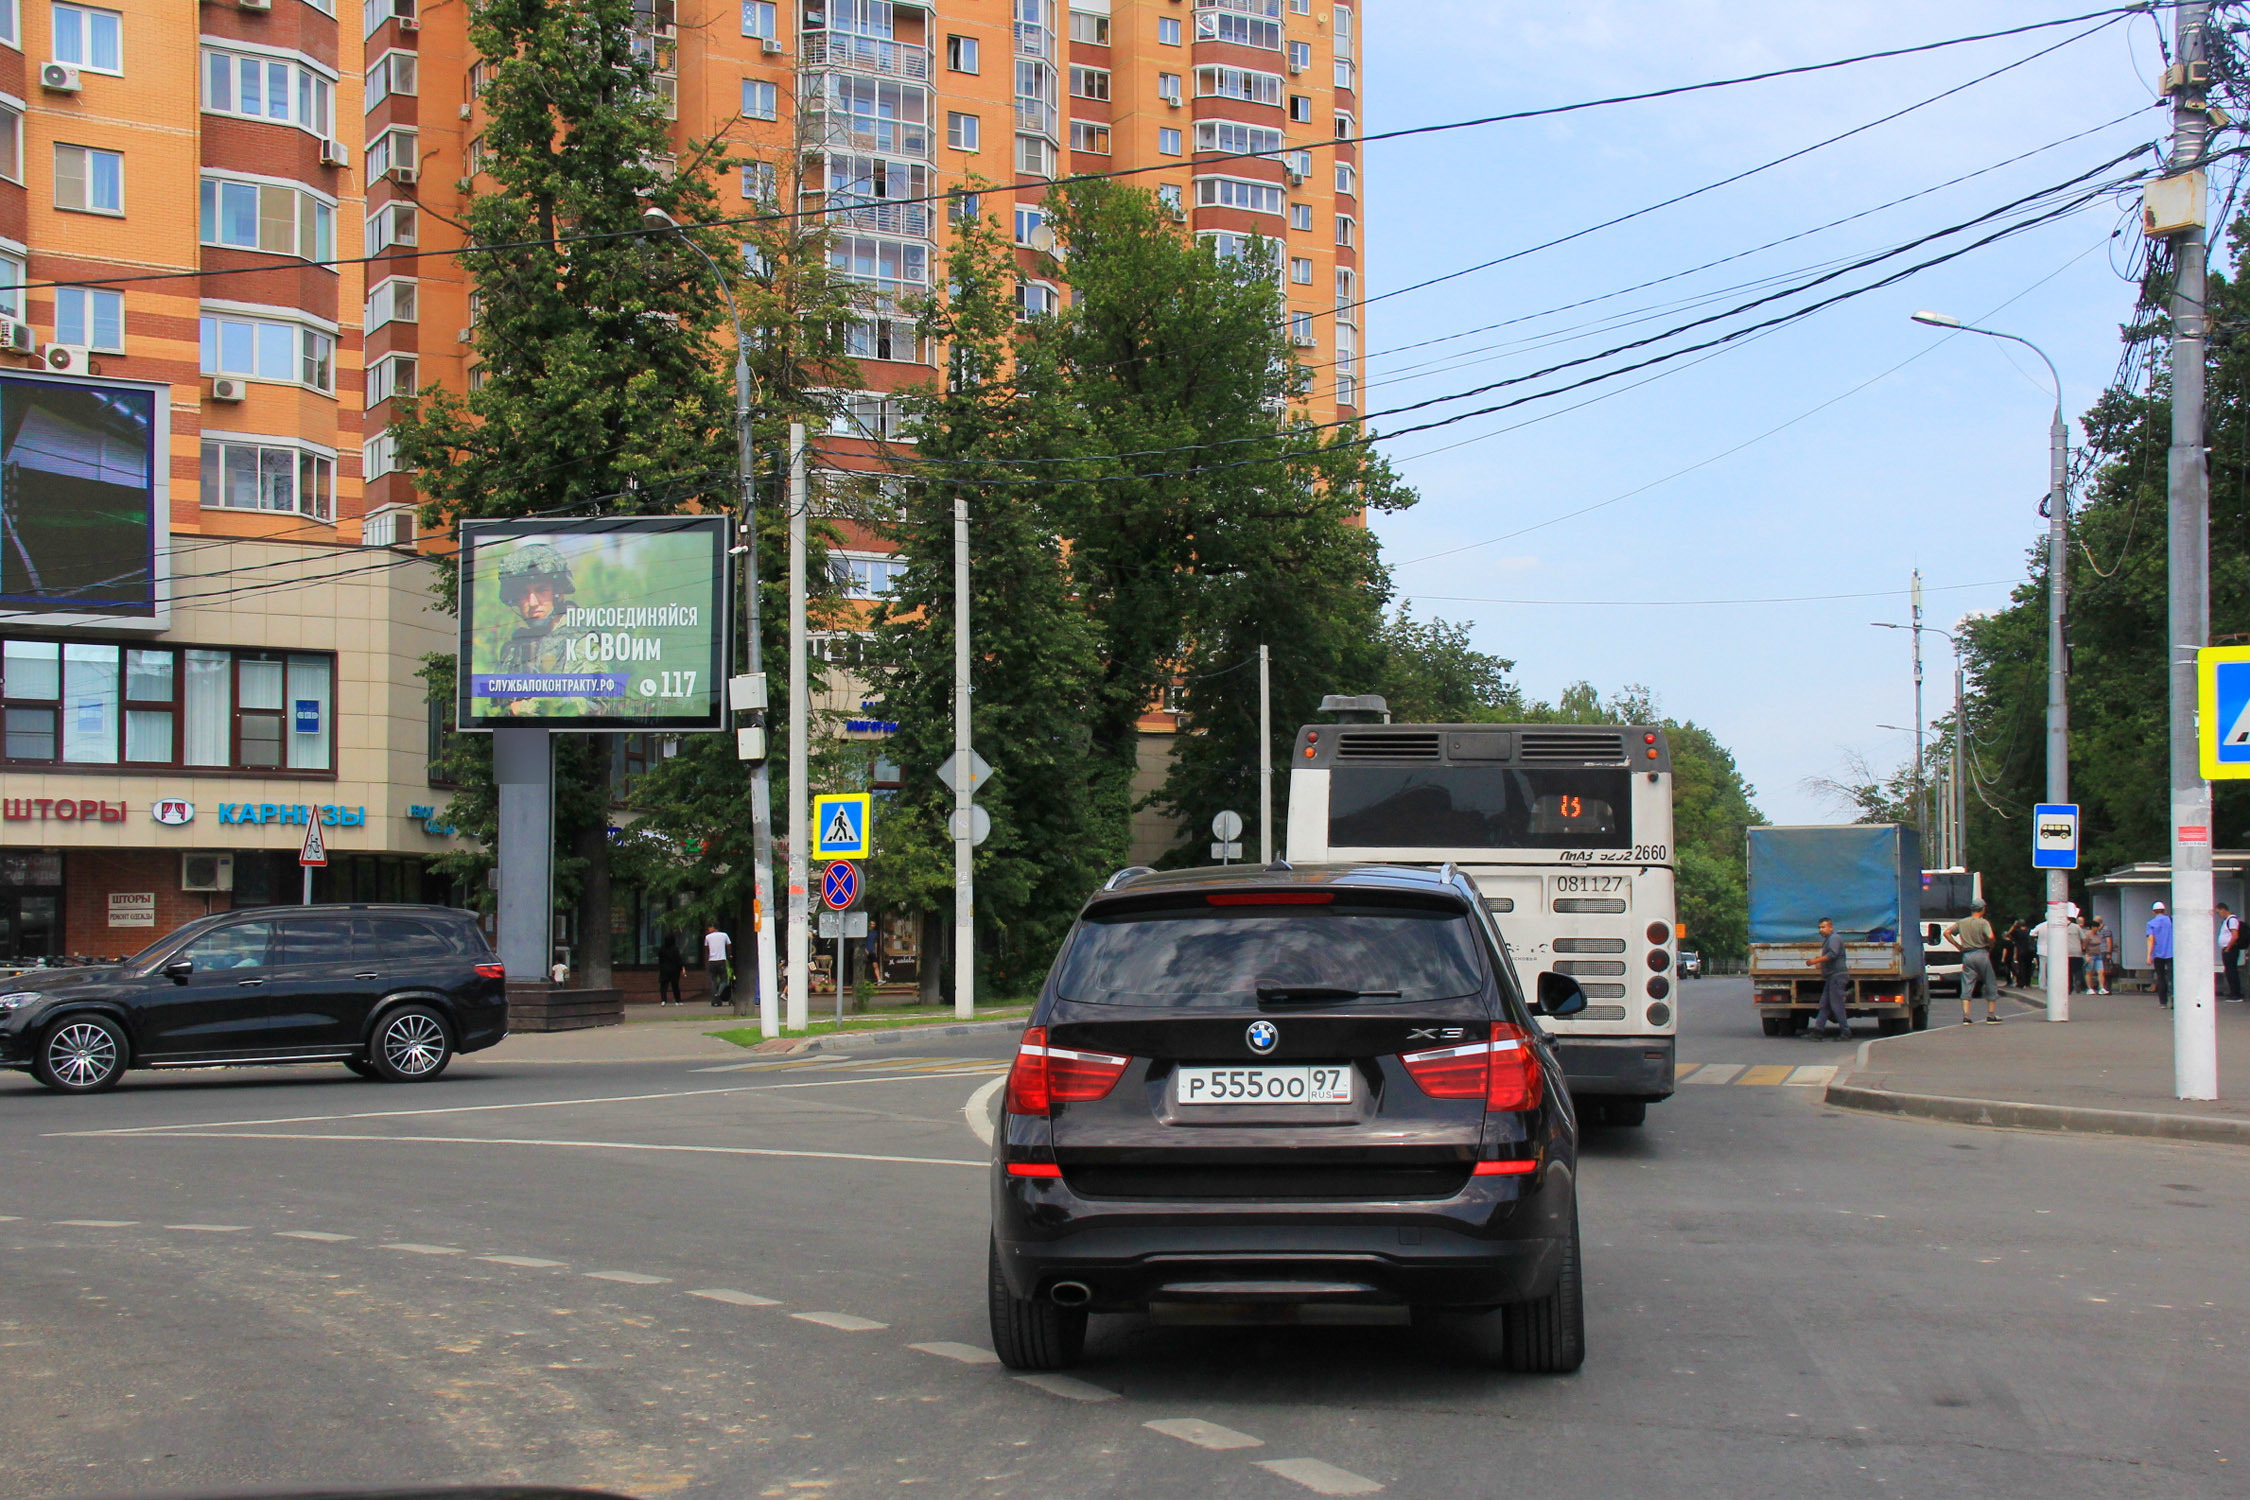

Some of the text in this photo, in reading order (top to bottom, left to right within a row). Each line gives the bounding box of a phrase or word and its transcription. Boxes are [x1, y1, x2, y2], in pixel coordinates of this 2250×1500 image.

[566, 602, 698, 629] ПРИСОЕДИНЯЙСЯ
[488, 678, 615, 692] СЛУЖБАПОКОНТРАКТУ.РФ
[660, 671, 697, 697] 117
[3, 798, 127, 821] ШТОРЫ
[1634, 844, 1667, 860] 2660
[1557, 875, 1623, 892] 081127
[112, 894, 151, 903] ШТОРЫ
[1406, 1027, 1464, 1039] X3
[1313, 1070, 1340, 1091] 97
[1311, 1091, 1332, 1099] RUS
